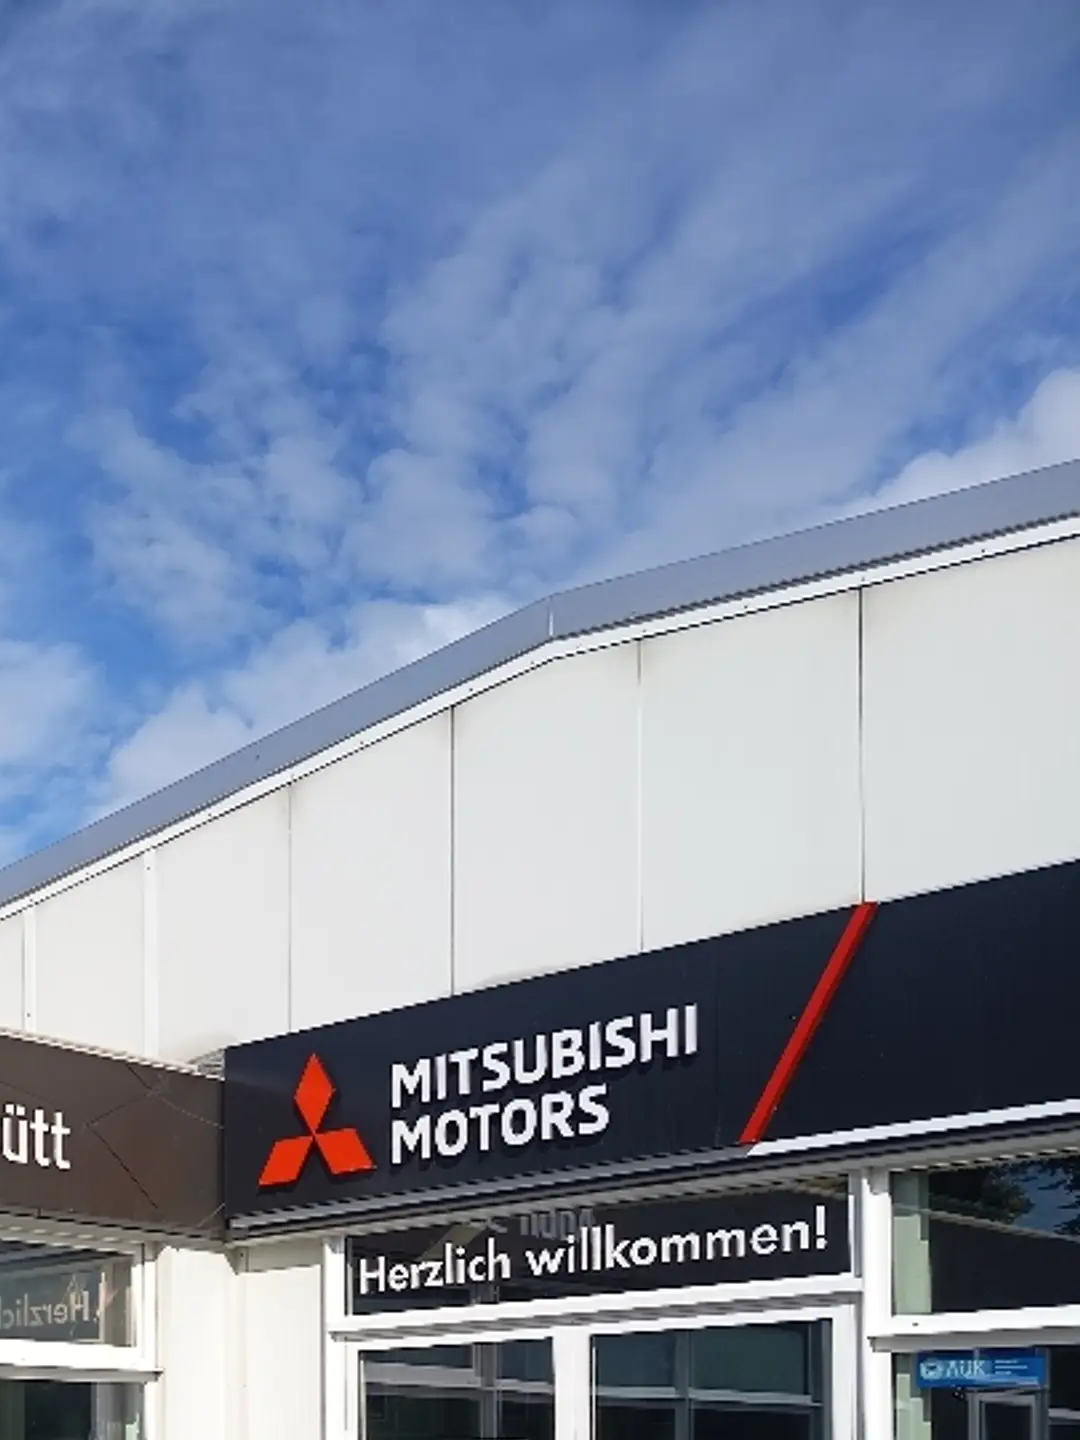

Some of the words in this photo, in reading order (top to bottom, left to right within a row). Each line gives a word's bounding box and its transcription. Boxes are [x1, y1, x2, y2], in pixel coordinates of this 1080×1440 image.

[391, 1003, 700, 1108] MITSUBISHI
[391, 1084, 611, 1164] MOTORS
[358, 1236, 512, 1295] Herzlich
[525, 1205, 829, 1276] willkommen!
